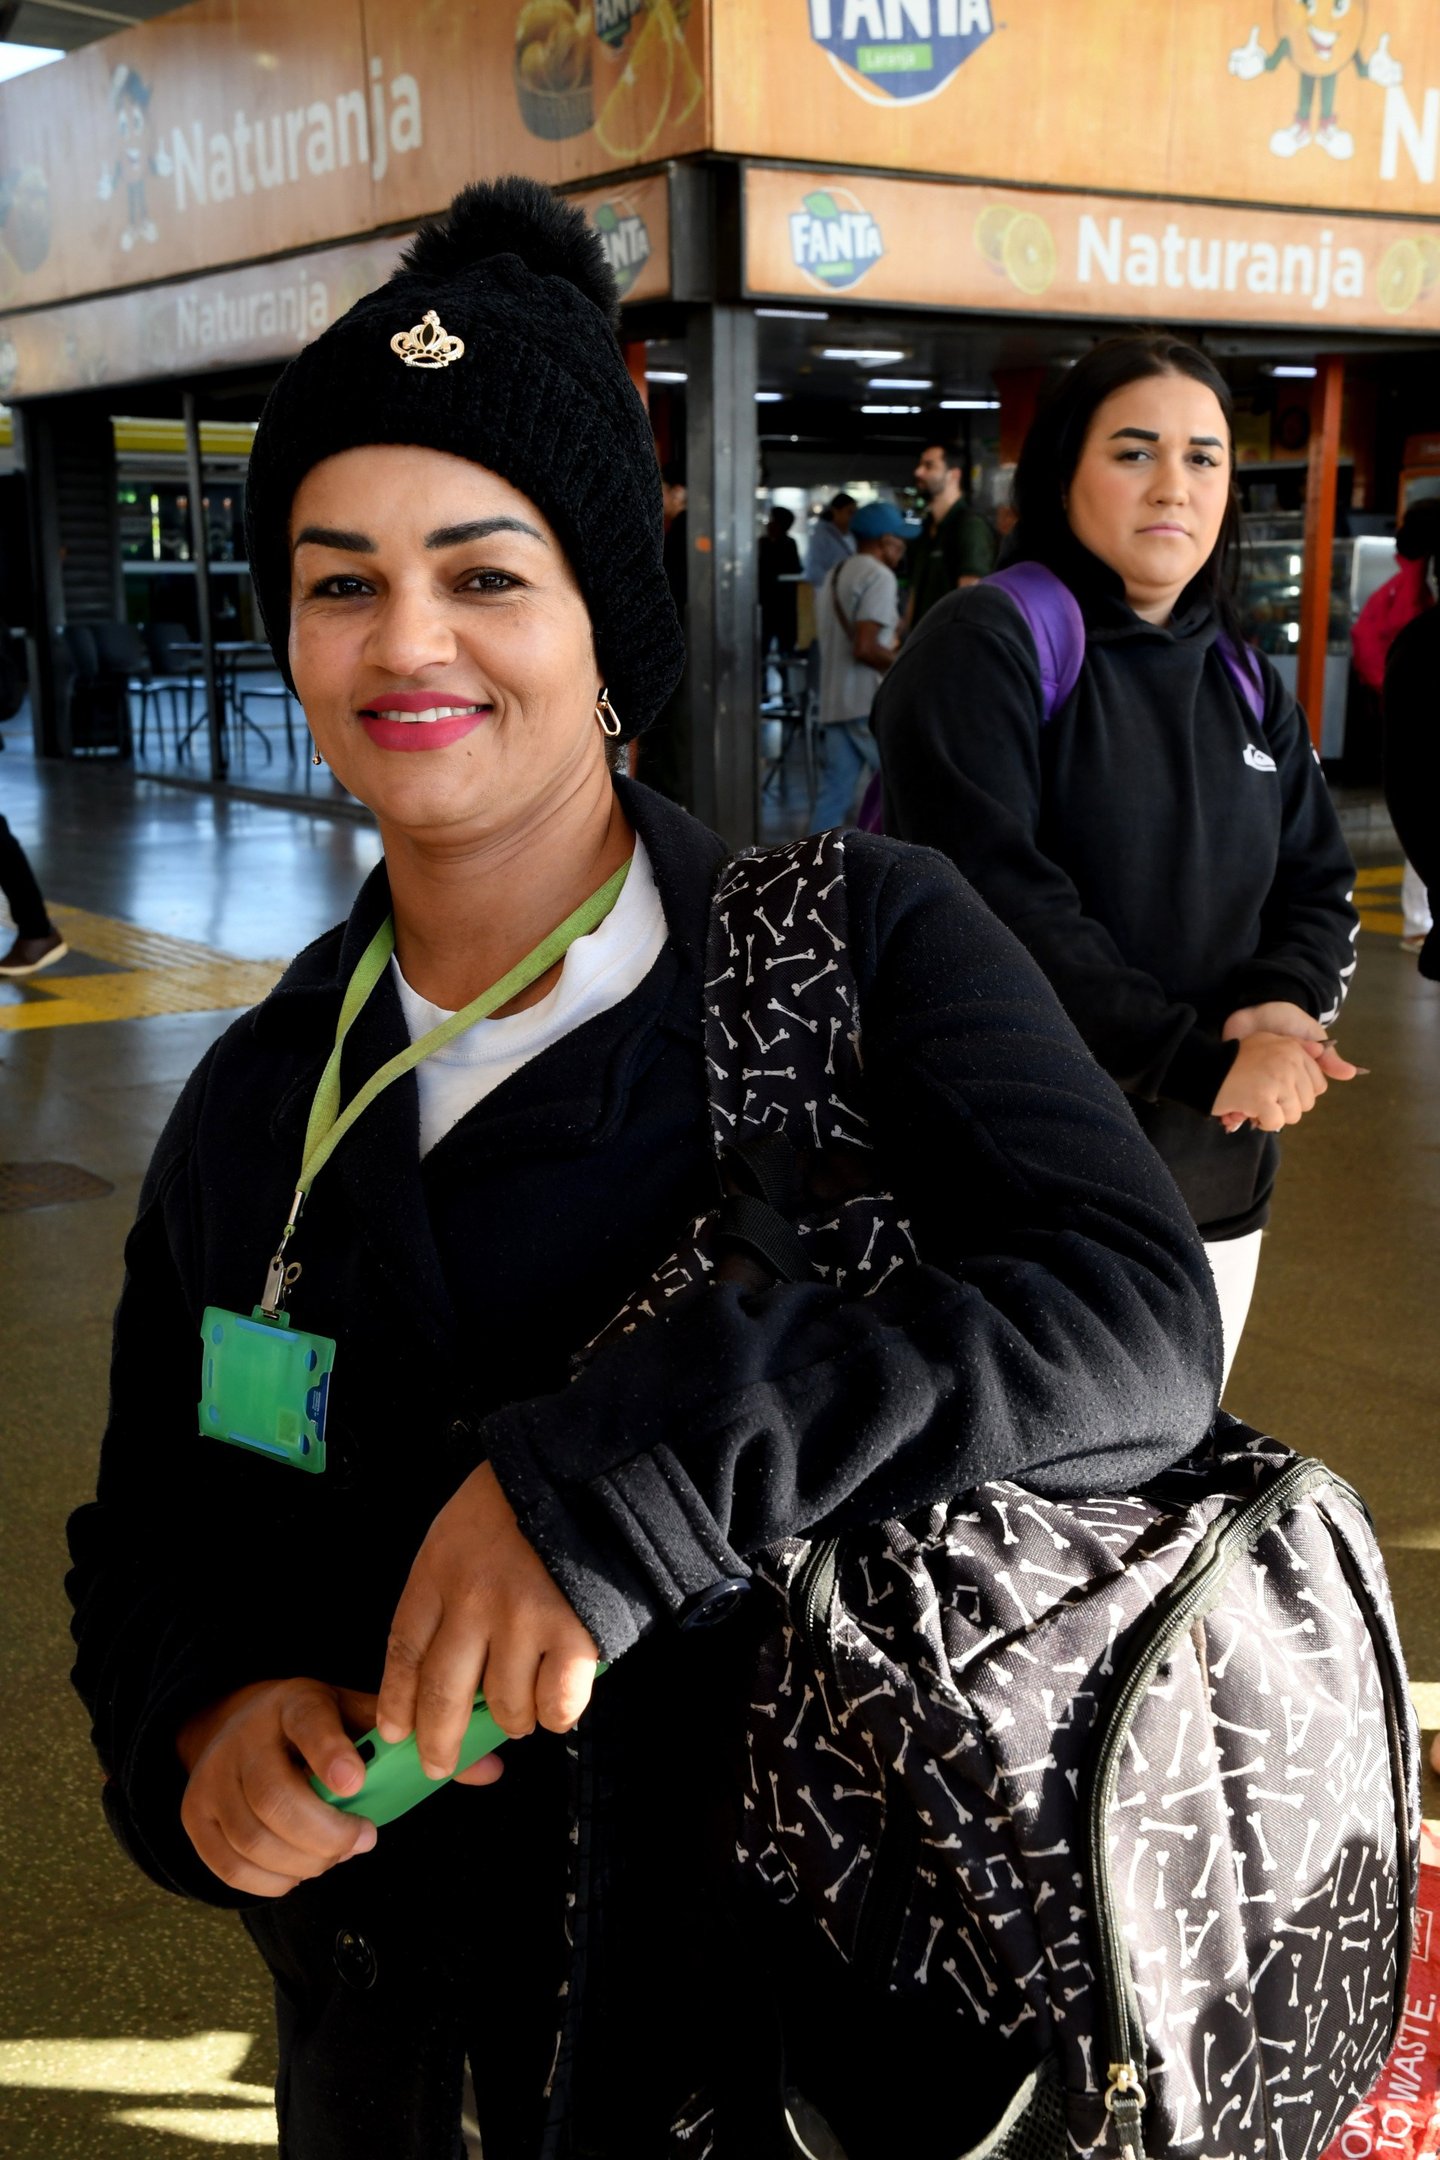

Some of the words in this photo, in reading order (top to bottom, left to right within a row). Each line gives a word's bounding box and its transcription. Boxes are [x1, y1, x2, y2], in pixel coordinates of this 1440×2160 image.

[171, 56, 423, 213] Naturanja
[790, 212, 883, 265] FANTA
[1076, 214, 1365, 311] Naturanja
[176, 269, 328, 349] Naturanja
[1387, 1993, 1438, 2103] WASTE.
[1376, 2108, 1414, 2150] TO
